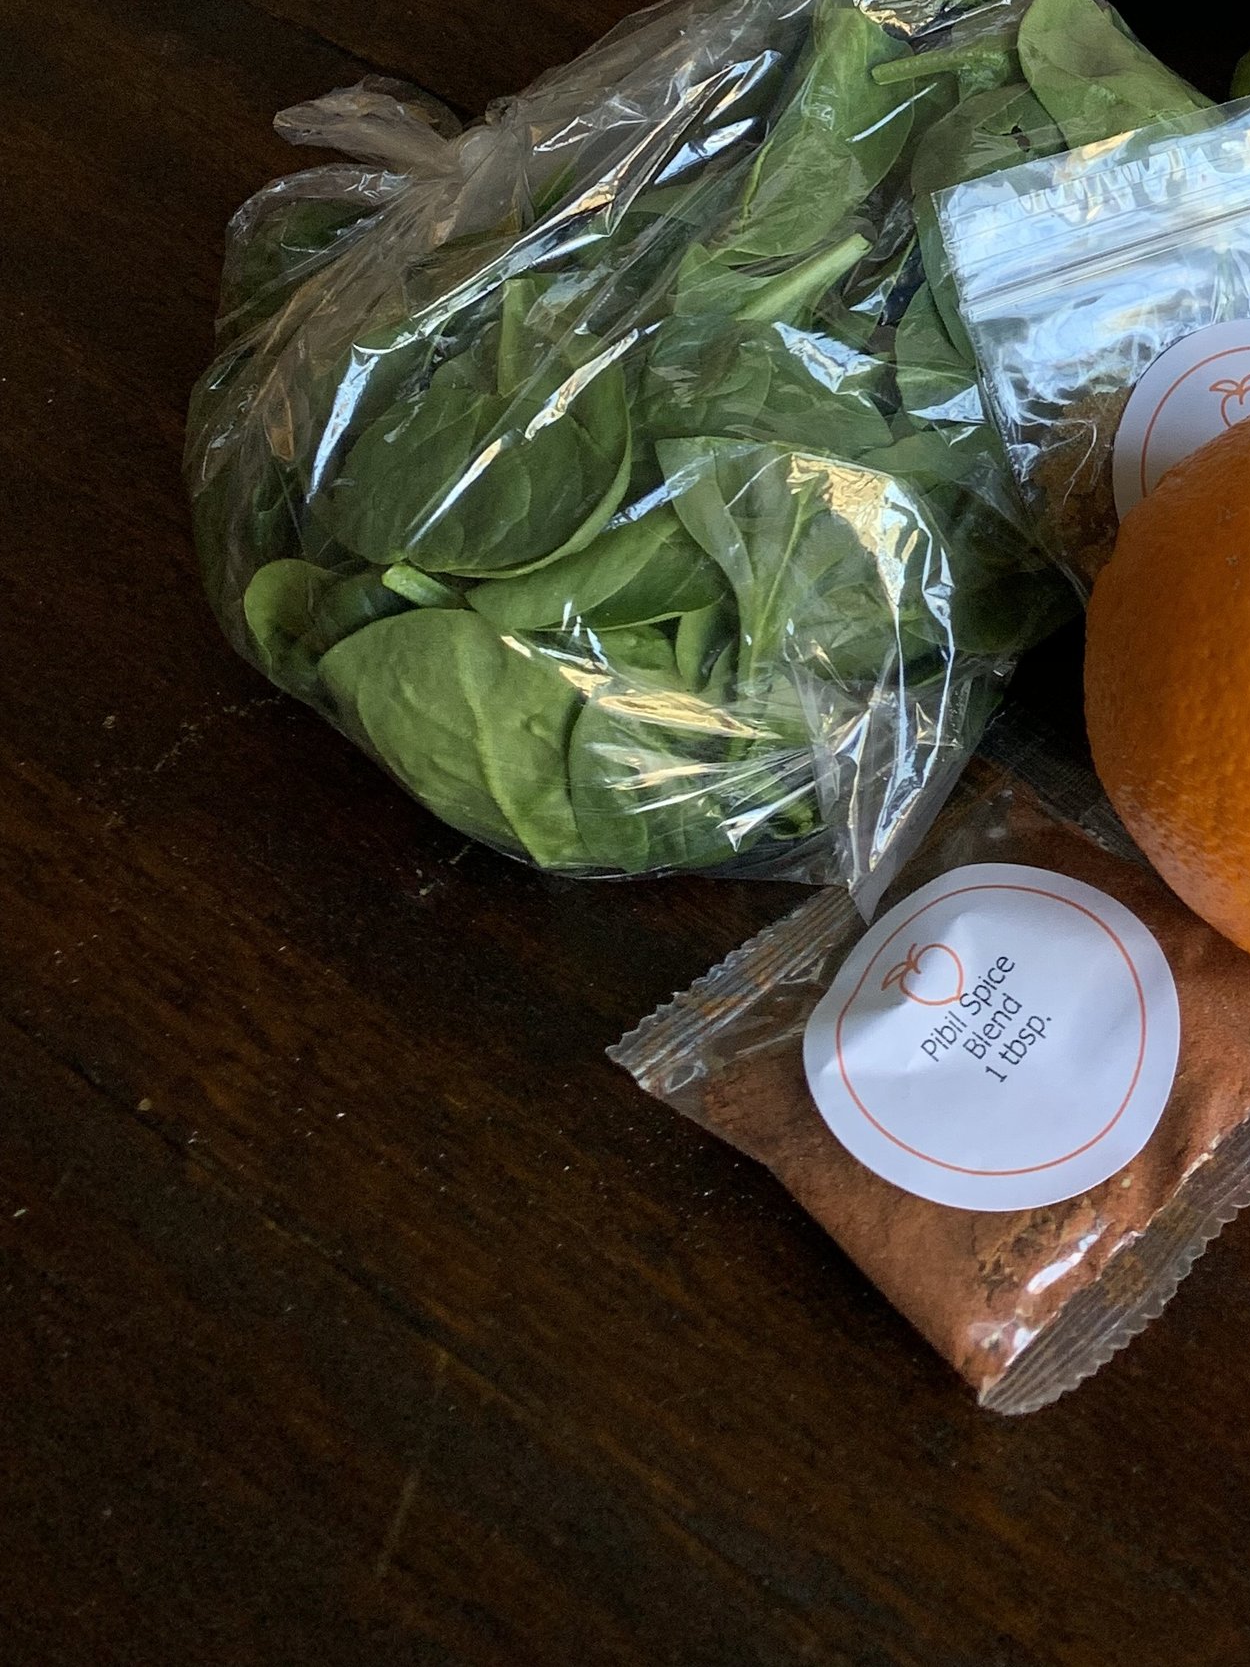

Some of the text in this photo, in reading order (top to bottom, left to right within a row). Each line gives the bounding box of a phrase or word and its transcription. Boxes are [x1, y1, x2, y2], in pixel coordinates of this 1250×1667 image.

[921, 956, 1016, 1062] Pibil Spice
[962, 993, 1022, 1060] Blend
[986, 1015, 1052, 1083] 1 tbsp.
